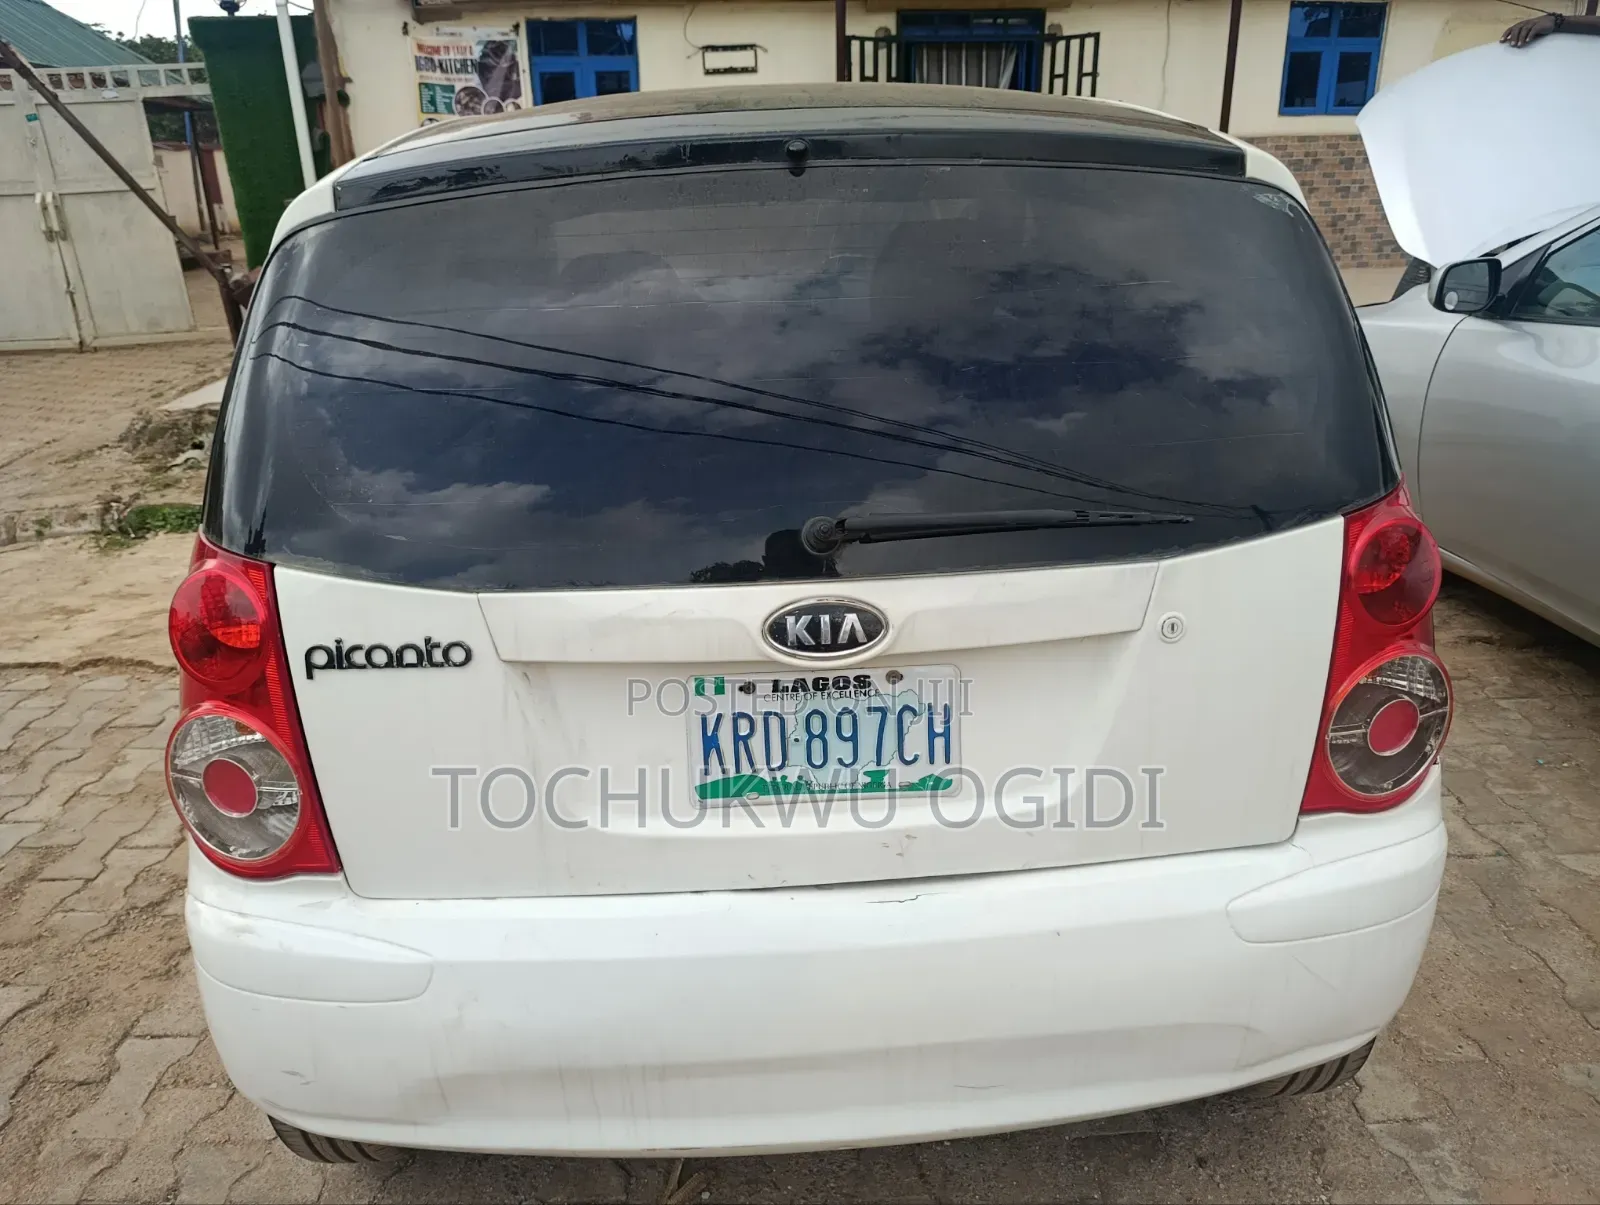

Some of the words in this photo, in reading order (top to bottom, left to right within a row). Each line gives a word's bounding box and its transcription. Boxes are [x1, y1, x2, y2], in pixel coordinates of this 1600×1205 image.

[785, 613, 868, 646] KIA
[305, 636, 472, 680] picanto
[763, 693, 801, 702] CENTRE
[803, 692, 818, 701] OF
[820, 688, 881, 701] EXCELLENCE
[772, 675, 872, 693] LAGOS
